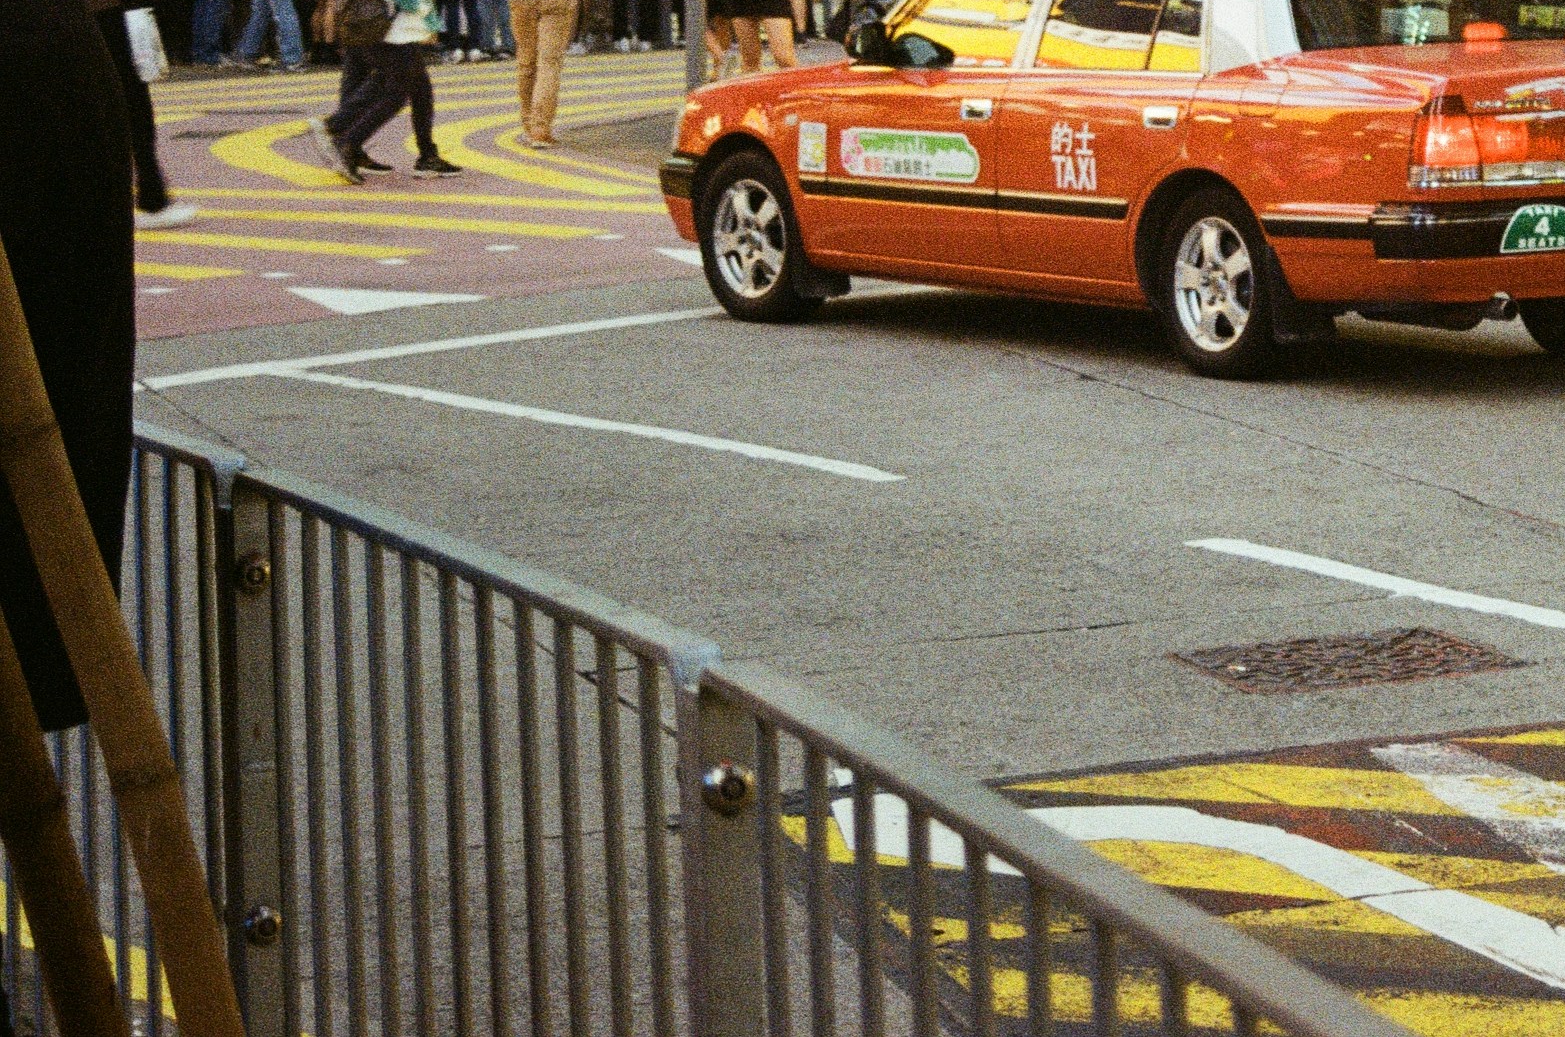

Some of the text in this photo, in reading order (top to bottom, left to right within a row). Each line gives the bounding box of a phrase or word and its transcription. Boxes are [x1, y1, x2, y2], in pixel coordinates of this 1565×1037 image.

[1050, 121, 1097, 156] 的士
[1050, 154, 1098, 191] TAXI
[1533, 215, 1552, 236] 4
